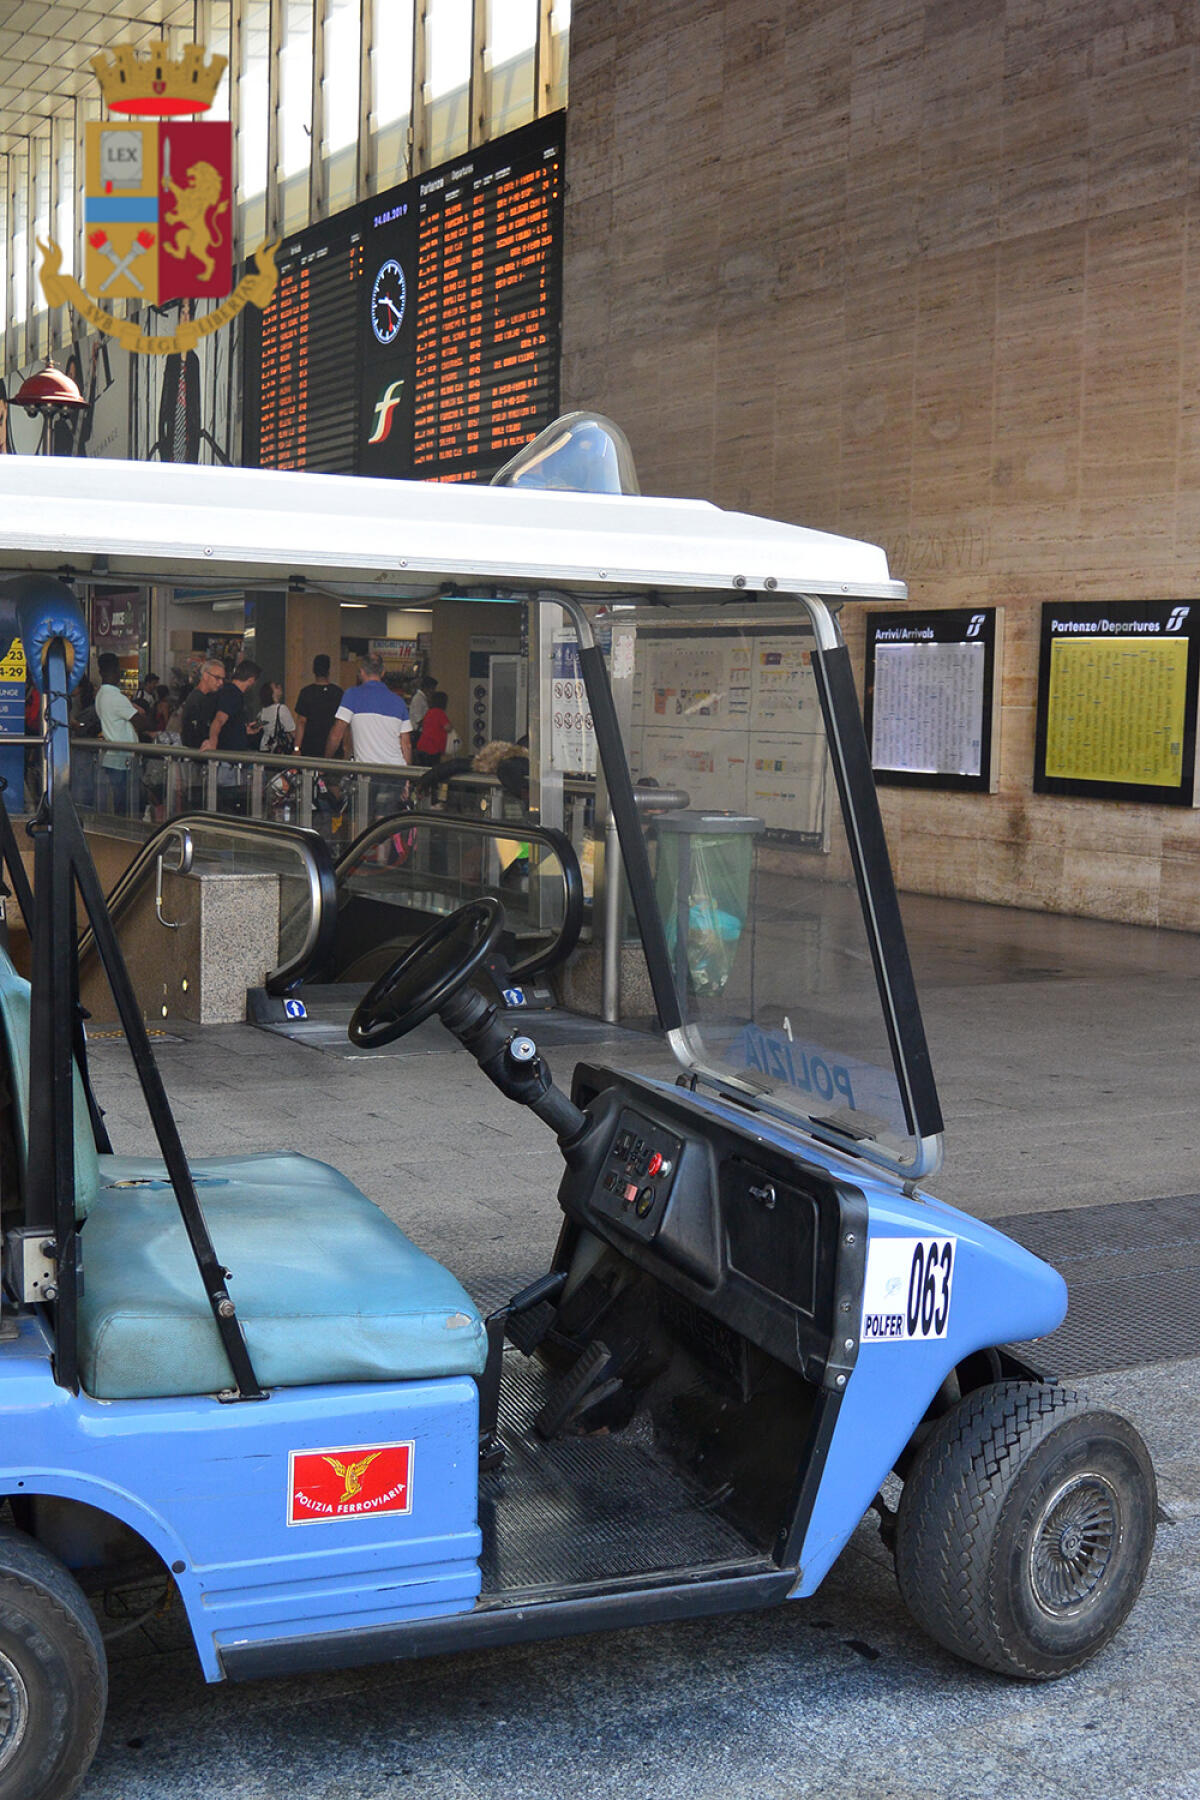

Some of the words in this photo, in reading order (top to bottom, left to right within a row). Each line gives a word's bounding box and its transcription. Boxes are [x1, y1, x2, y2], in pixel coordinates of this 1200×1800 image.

[875, 627, 935, 640] Arrivi/Arrivals
[1051, 618, 1161, 635] Partenze/Departures
[906, 1241, 952, 1336] 063
[864, 1315, 903, 1337] POLFER
[295, 1491, 333, 1513] POLIZIA
[337, 1483, 406, 1513] FERROVIARIA
